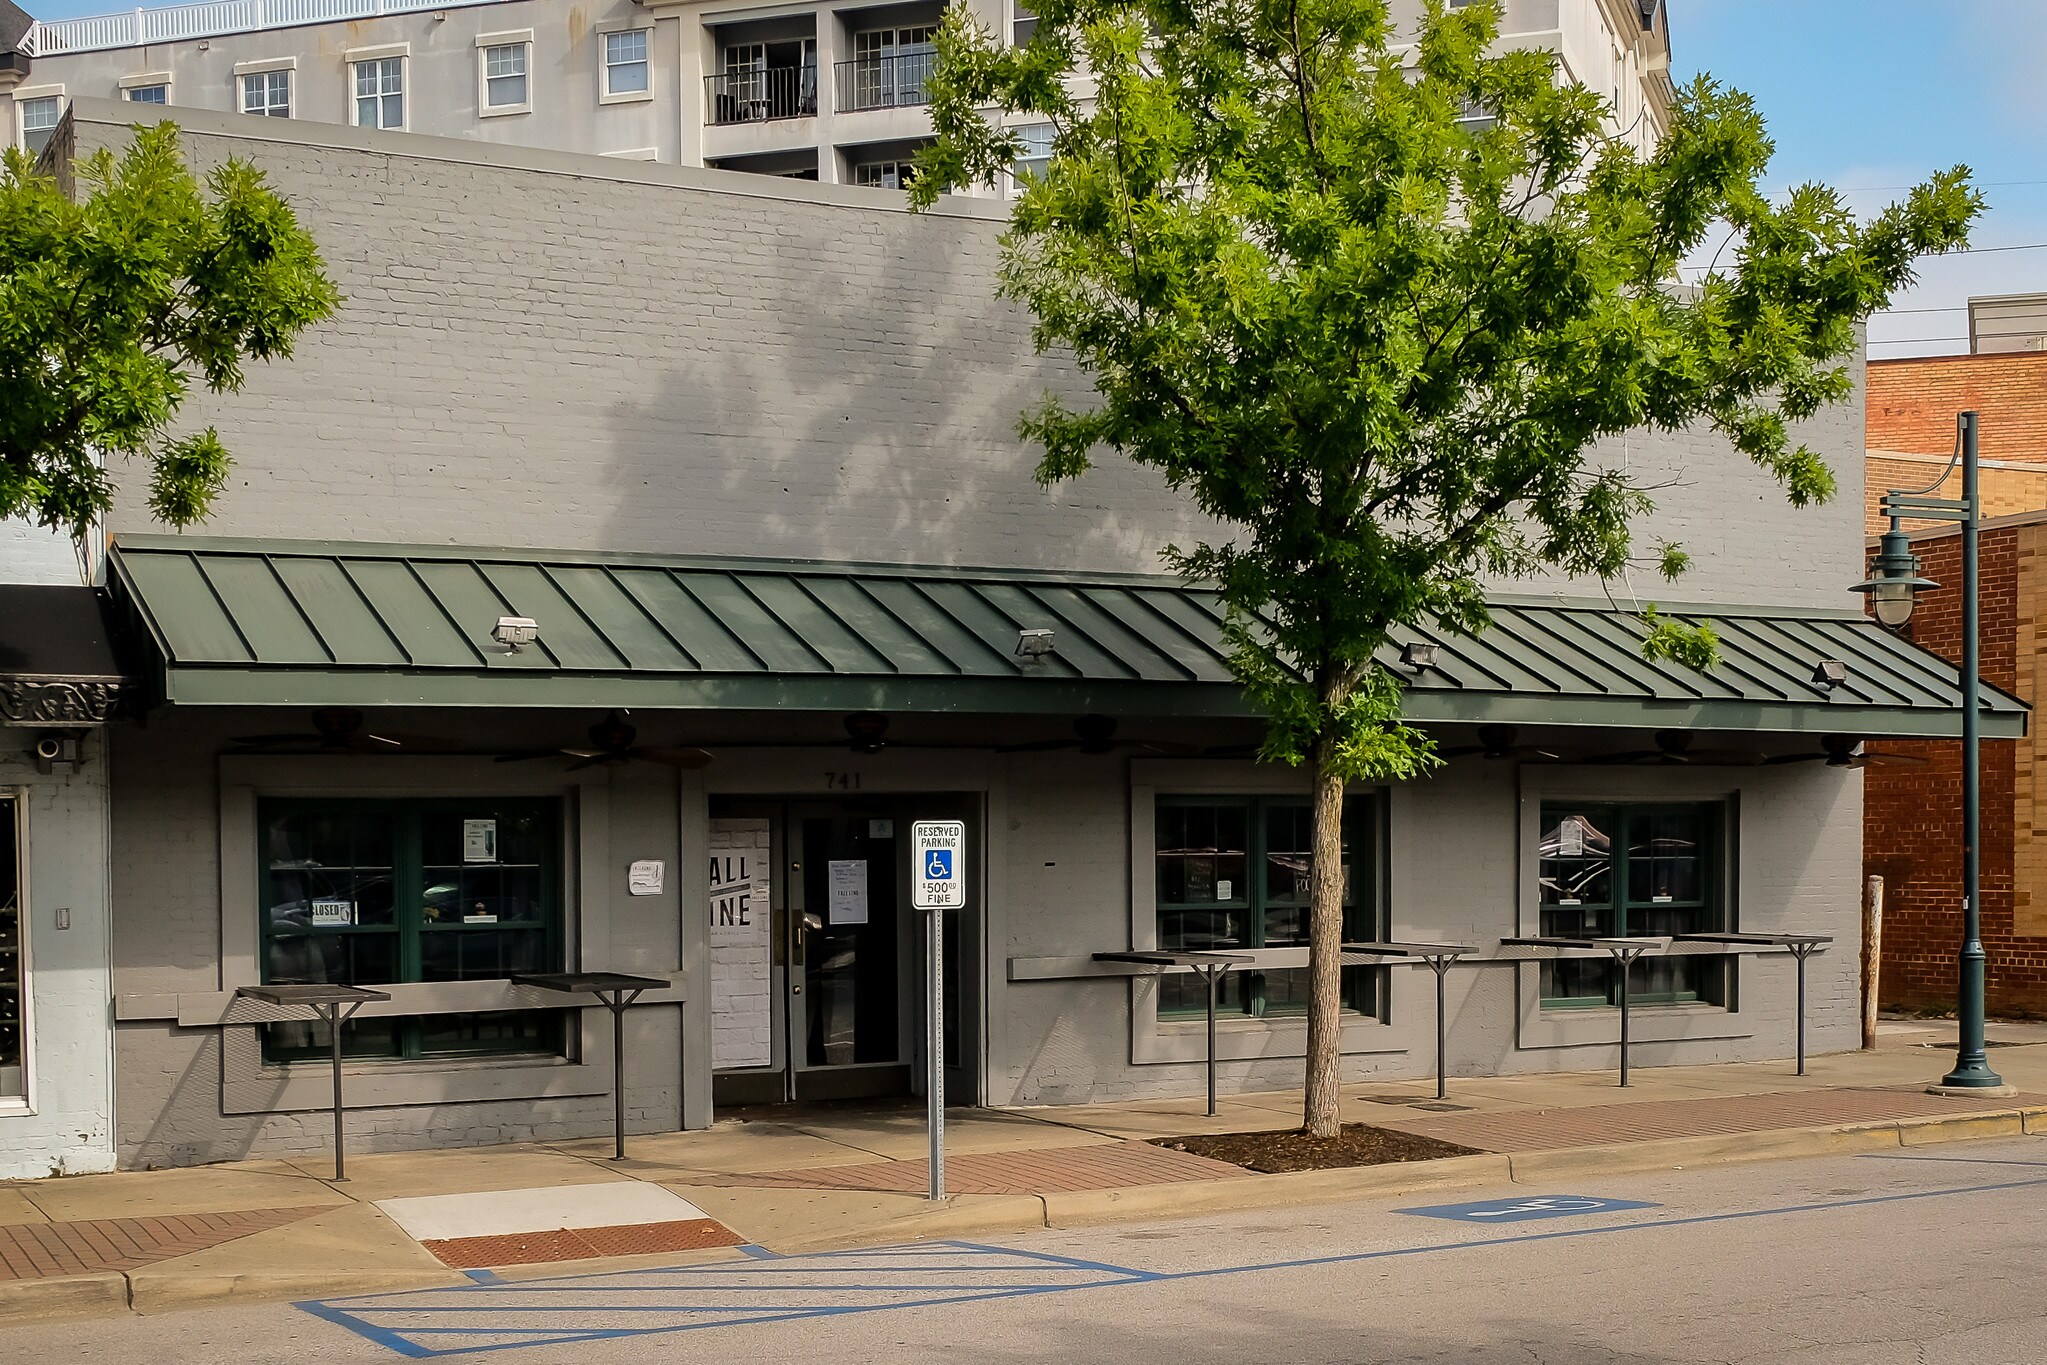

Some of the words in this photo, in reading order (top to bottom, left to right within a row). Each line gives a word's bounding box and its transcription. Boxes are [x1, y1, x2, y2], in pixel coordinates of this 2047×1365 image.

[825, 772, 861, 789] 741
[917, 826, 960, 837] RESERVED
[921, 837, 956, 848] PARKING
[927, 894, 951, 904] FINE
[312, 904, 340, 916] LOSED
